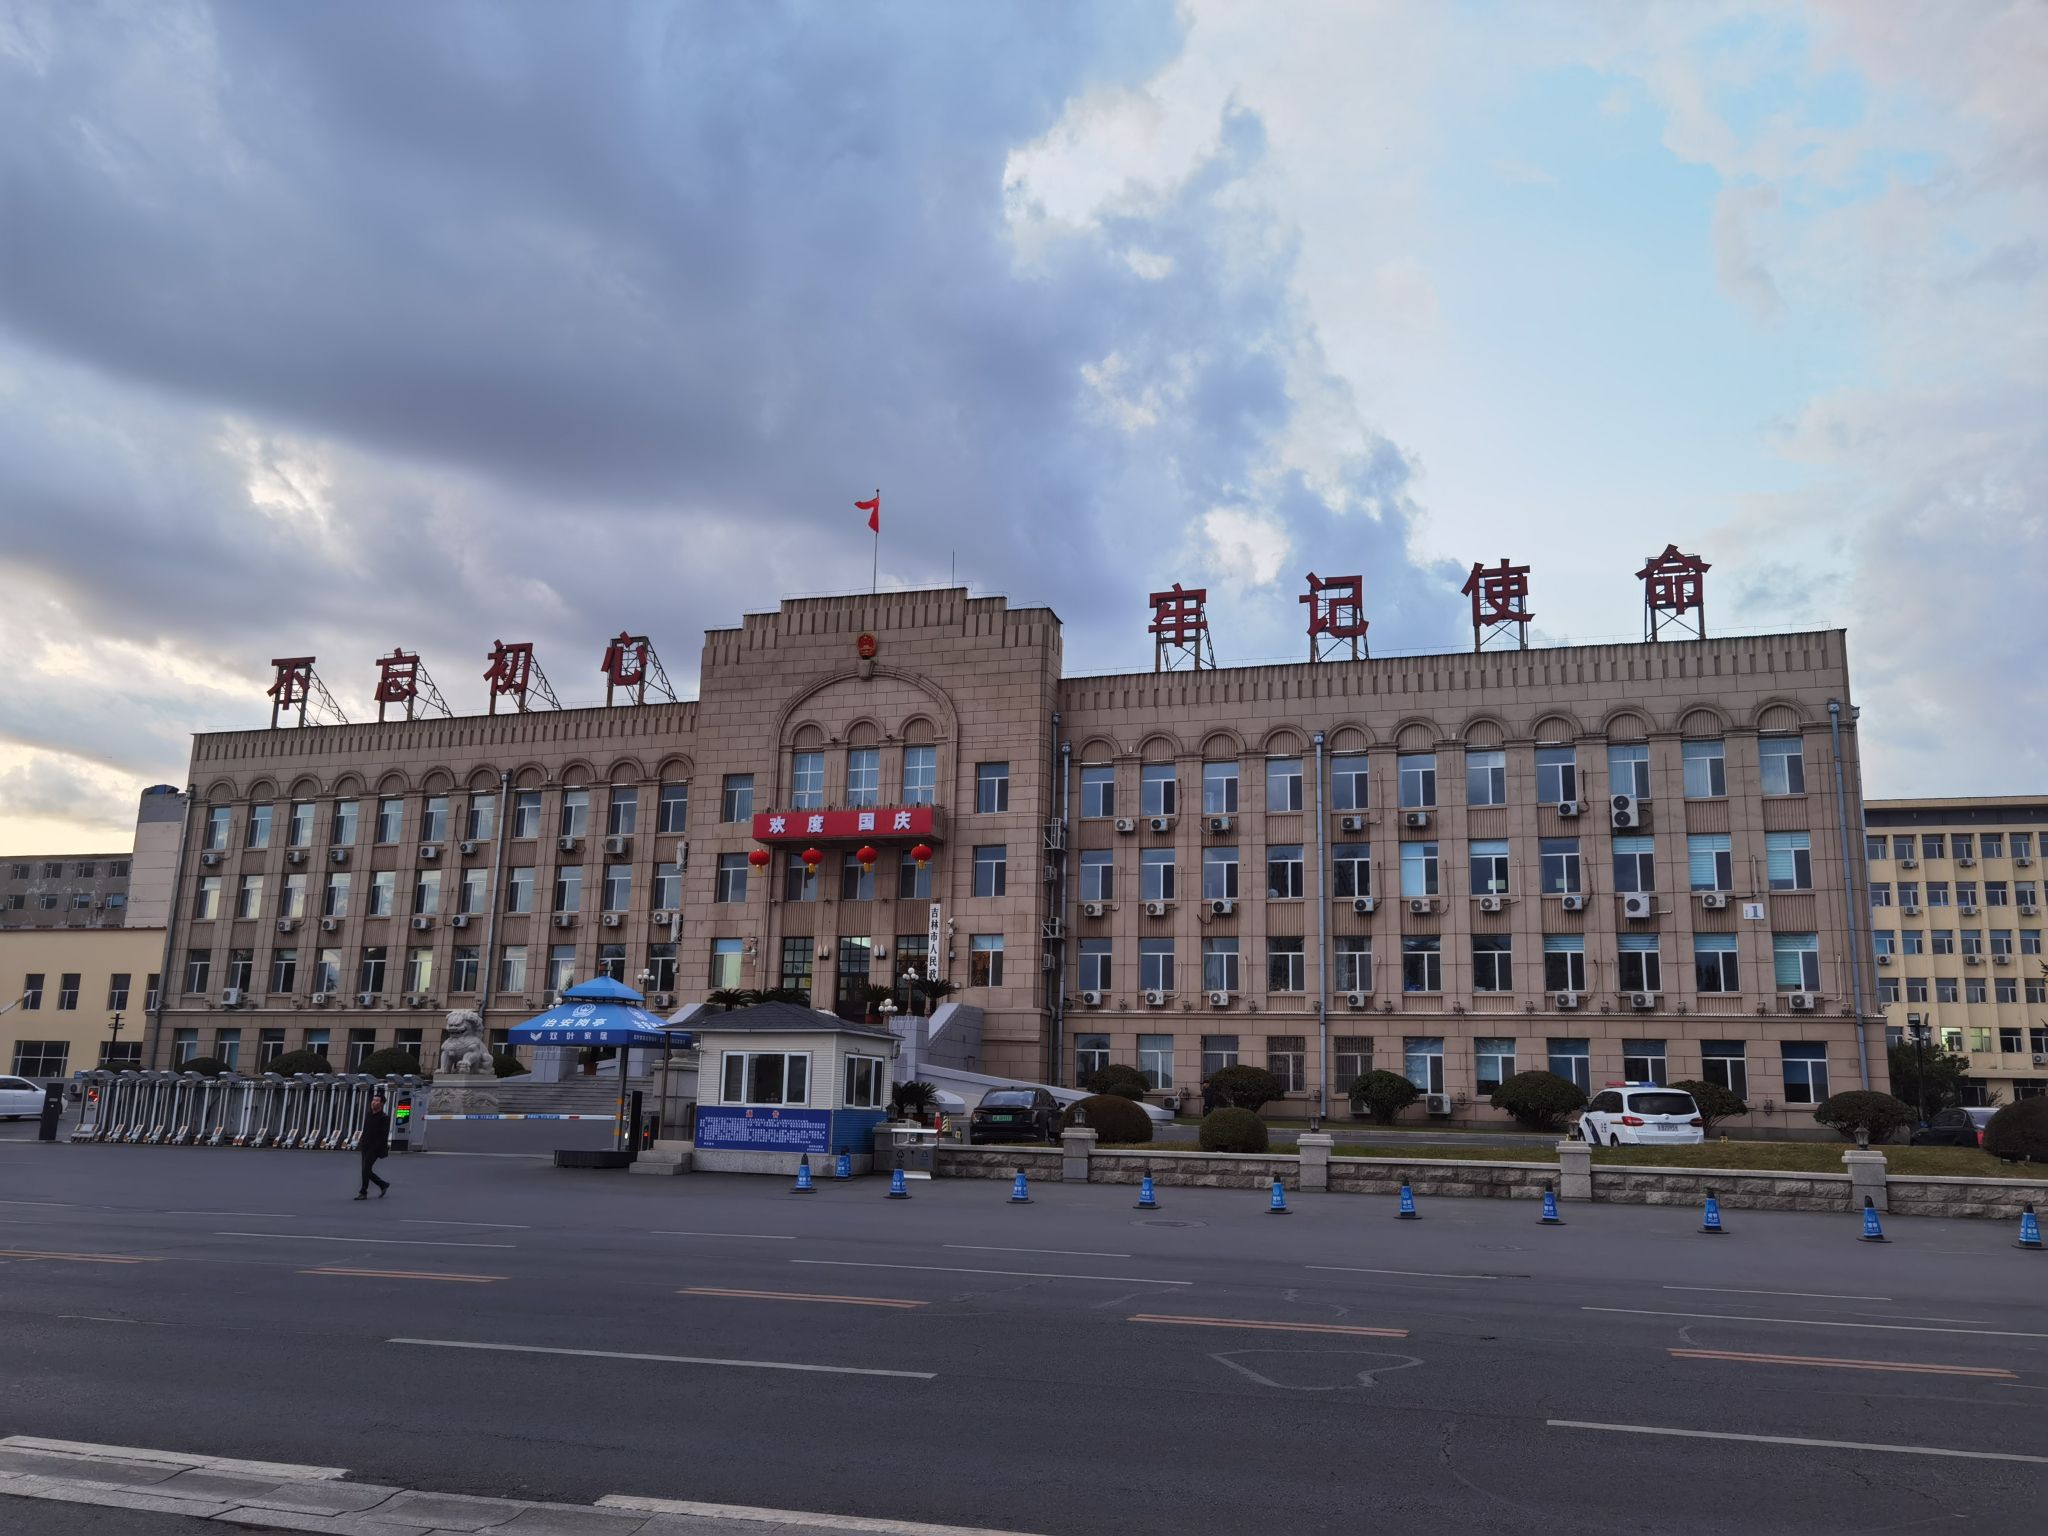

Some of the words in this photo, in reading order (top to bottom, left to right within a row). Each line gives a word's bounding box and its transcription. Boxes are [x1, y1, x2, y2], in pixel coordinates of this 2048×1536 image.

[1148, 543, 1712, 647] 牢记使命
[267, 631, 647, 710] 不忘初心
[768, 810, 912, 834] 欢度国庆
[1751, 905, 1761, 918] 1
[542, 1018, 607, 1027] 治安岗亭
[549, 1031, 608, 1041] 双叶家居
